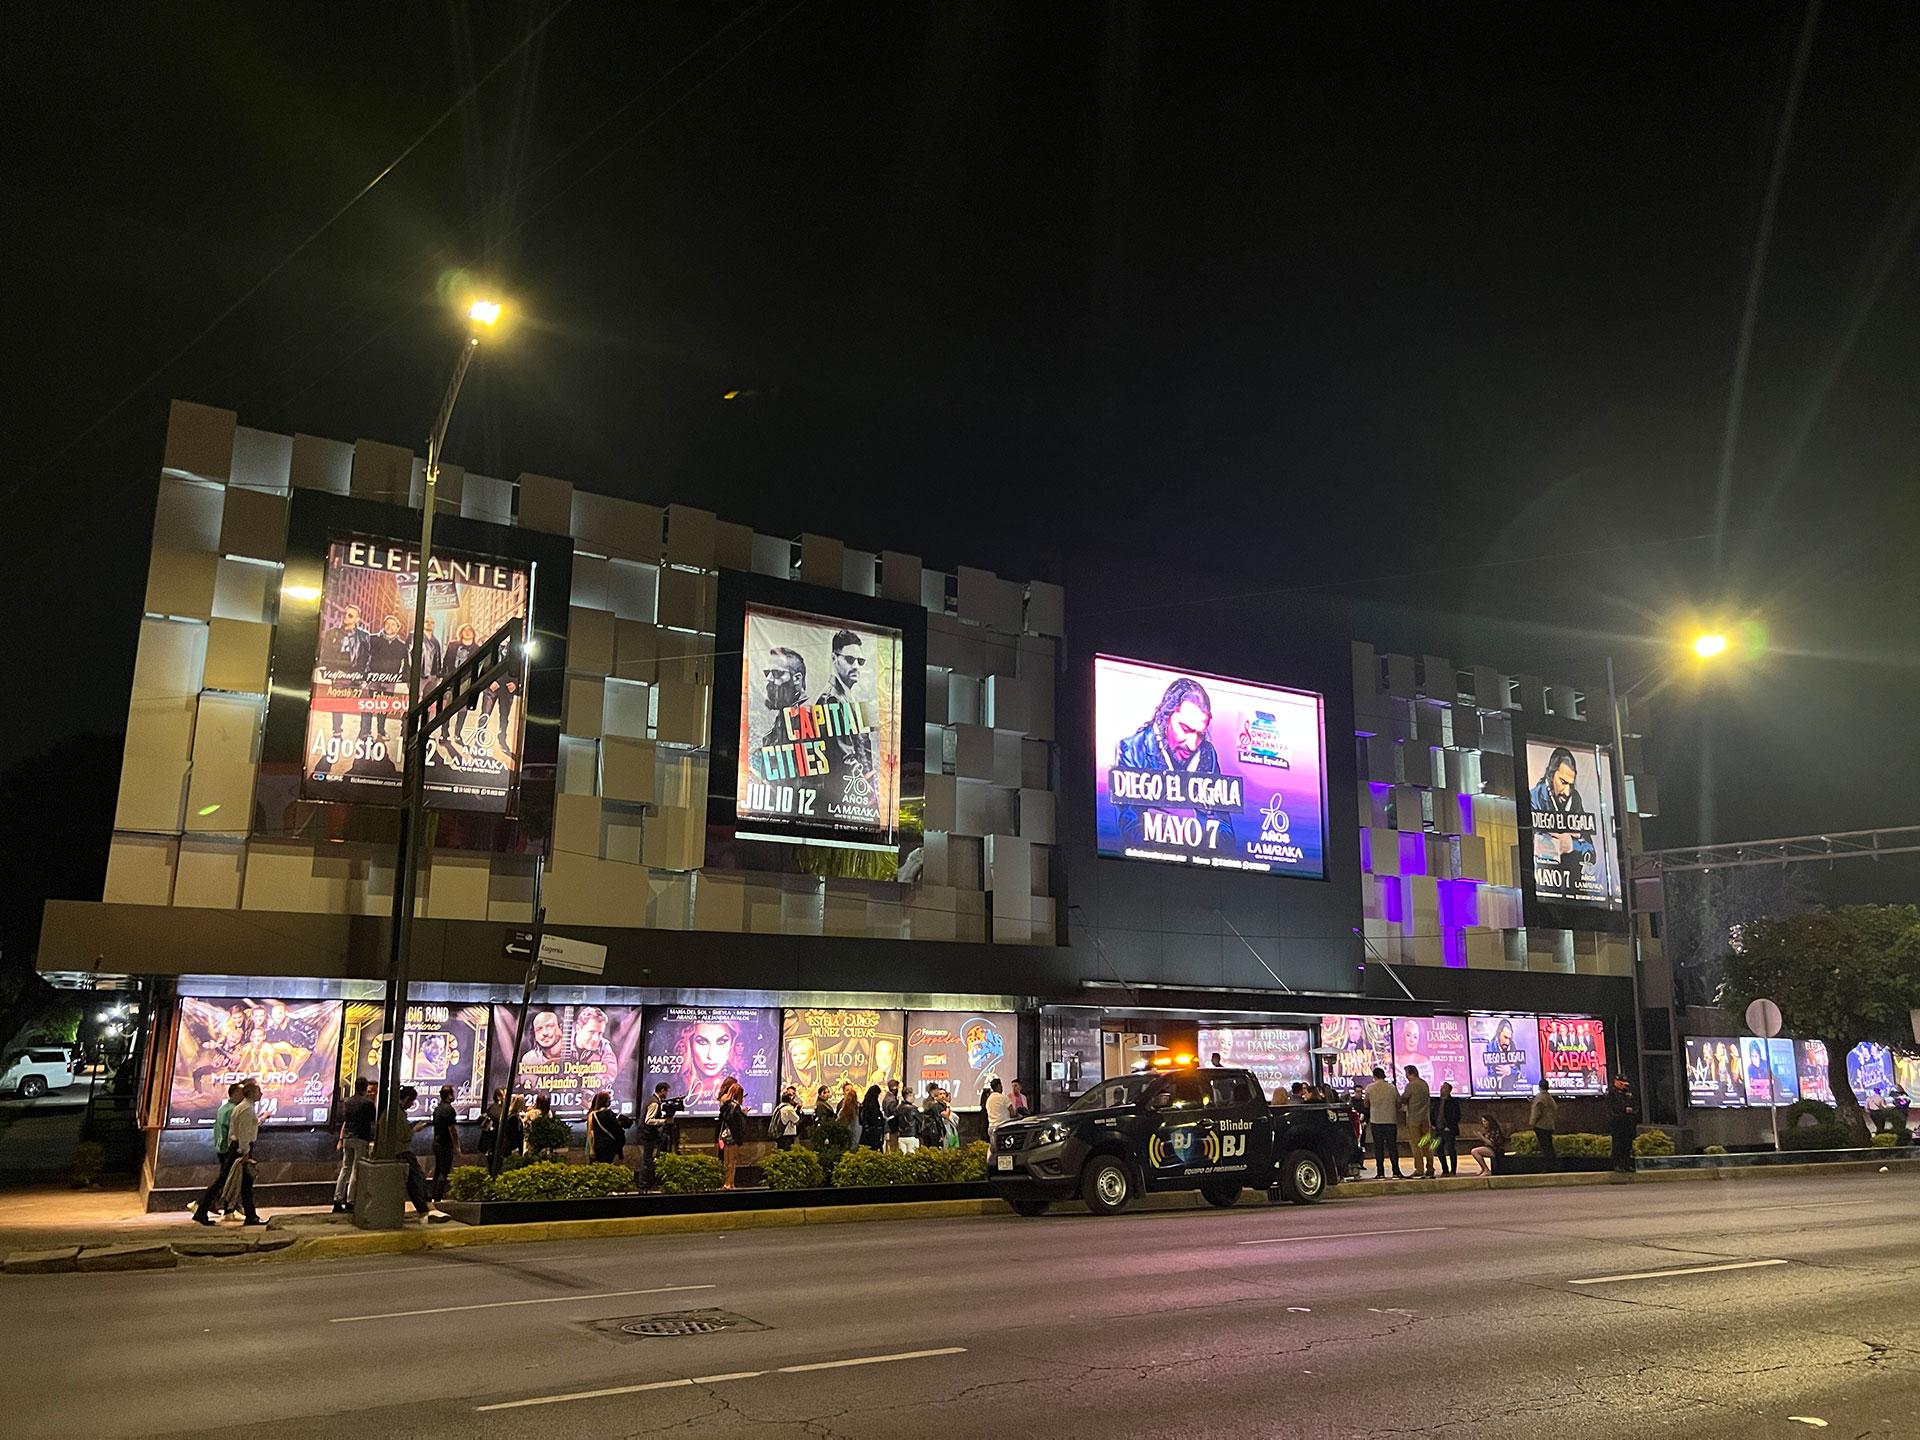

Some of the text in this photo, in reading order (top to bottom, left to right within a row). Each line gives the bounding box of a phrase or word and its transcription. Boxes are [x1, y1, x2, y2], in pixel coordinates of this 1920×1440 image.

[348, 541, 508, 589] ELEFANTE
[366, 672, 403, 683] FORMAL
[358, 700, 410, 712] SOLD OU
[783, 702, 871, 741] CAPITAL
[311, 728, 387, 765] Agosto
[461, 745, 495, 757] AÑOS
[461, 758, 510, 771] MARAKA
[761, 741, 830, 781] CITIES
[1112, 770, 1242, 807] DIEGO EL CIGALA
[740, 782, 817, 815] JULIO 12
[842, 795, 869, 806] AÑOS
[828, 803, 841, 814] LA
[842, 804, 880, 819] MARAKA
[1531, 811, 1595, 831] DIEGO EL CIGALA
[1143, 811, 1220, 849] MAYO 7
[1261, 829, 1290, 843] AÑOS
[1247, 841, 1263, 854] LA
[1263, 843, 1304, 859] MARAKA
[1534, 868, 1571, 888] MAYO 7
[541, 944, 564, 955] Eugenia
[407, 1006, 449, 1022] BIG BAND
[809, 1015, 875, 1027] ESTELA CARLOS
[843, 1027, 875, 1038] CUEVAS
[647, 1056, 684, 1065] MARZO
[823, 1053, 866, 1067] JULIO 19
[1483, 1052, 1500, 1064] DIEGO
[1550, 1051, 1599, 1070] KABAH
[518, 1061, 607, 1077] Fernando Delgadillo
[649, 1065, 681, 1074] 26 & 27
[1255, 1072, 1283, 1080] ARZO
[523, 1080, 532, 1089] &
[536, 1076, 578, 1092] Alejandro
[914, 1080, 961, 1099] JUO 7
[1496, 1076, 1503, 1089] 7
[1574, 1077, 1585, 1088] 25
[550, 1093, 573, 1106] DIC
[574, 1093, 582, 1106] 5
[683, 1080, 721, 1108] Dul
[1219, 1118, 1253, 1131] Blindar
[1174, 1132, 1192, 1149] BJ
[1222, 1134, 1246, 1157] BJ
[1184, 1167, 1205, 1176] EQUIPO
